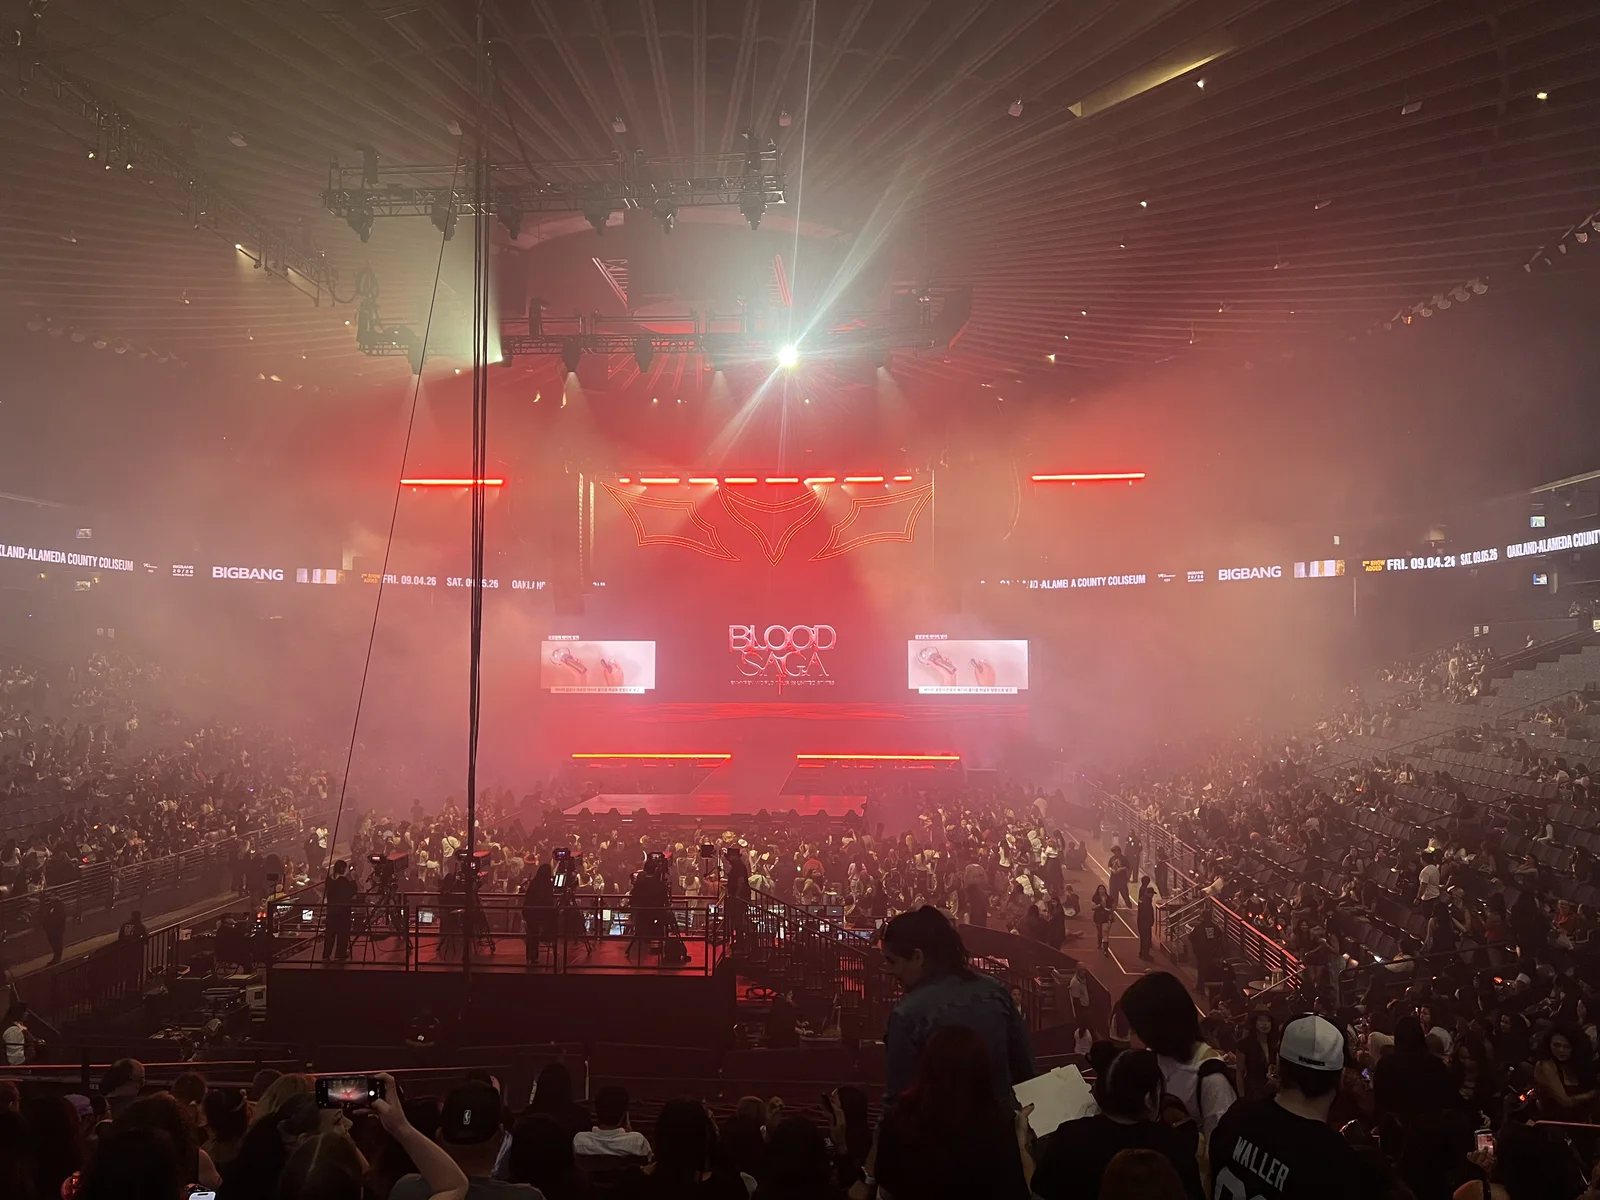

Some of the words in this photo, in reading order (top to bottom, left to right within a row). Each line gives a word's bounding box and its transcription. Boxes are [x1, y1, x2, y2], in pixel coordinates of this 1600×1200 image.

[1506, 534, 1573, 559] OAKLAND-ALAMEDA
[1572, 529, 1600, 548] COUNT
[67, 552, 98, 568] COUNTY
[98, 556, 134, 572] COLISEUM
[1386, 558, 1409, 571] FRI.
[1410, 556, 1455, 570] 09.04.26
[1460, 552, 1473, 566] SAT.
[1472, 547, 1498, 564] 09.05.26
[212, 566, 284, 582] BIGBANG
[382, 574, 399, 585] FRI.
[401, 575, 437, 586] 09.04.26
[1077, 576, 1107, 587] COUNTY
[1107, 574, 1146, 586] COLISEUM
[1218, 565, 1282, 581] BIGBANG
[446, 577, 464, 587] SAT.
[465, 578, 499, 589] 05.26
[728, 624, 837, 652] BLOOD
[736, 650, 830, 677] SAGA
[1232, 1136, 1290, 1192] WALLER
